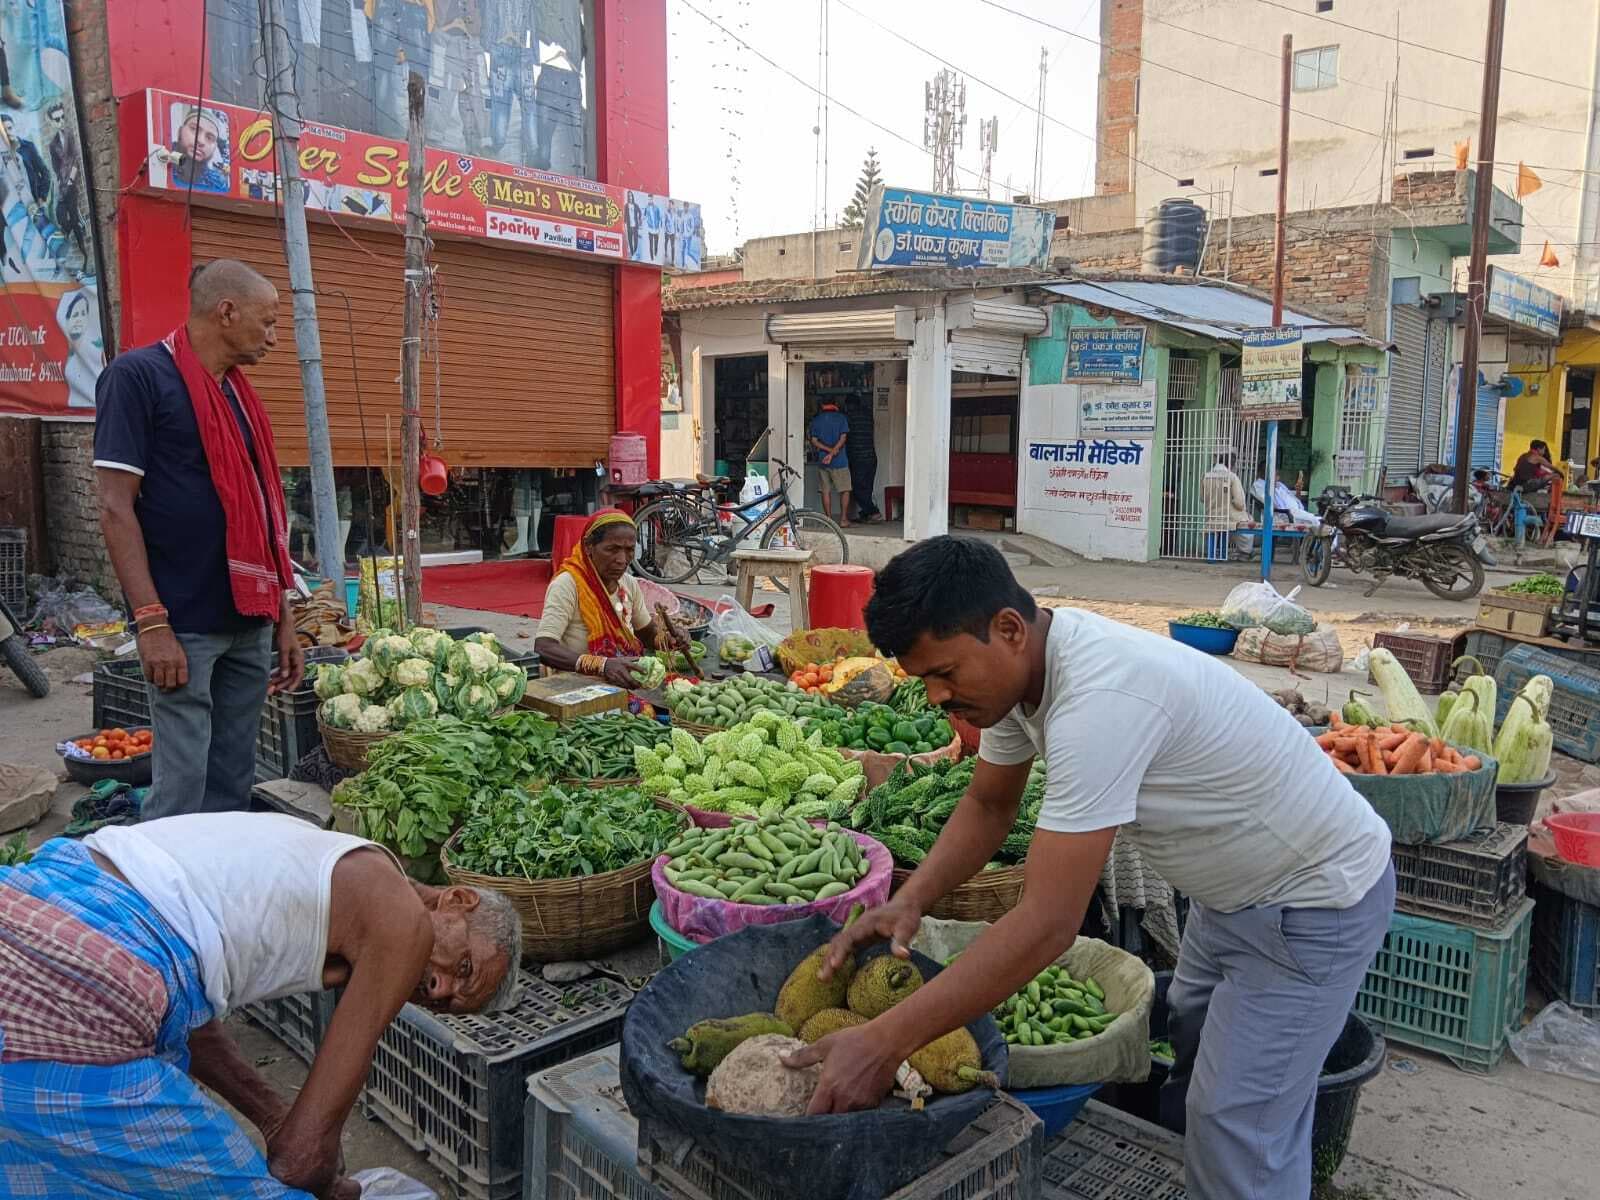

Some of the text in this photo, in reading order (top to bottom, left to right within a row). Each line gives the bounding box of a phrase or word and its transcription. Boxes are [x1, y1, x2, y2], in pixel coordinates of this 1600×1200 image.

[239, 119, 341, 174] Oer
[493, 179, 551, 209] Men's
[556, 190, 604, 218] Wear
[884, 195, 1009, 233] स्कीन केयर क्लिनिक
[490, 216, 540, 240] Sparky
[948, 237, 982, 259] कुमार
